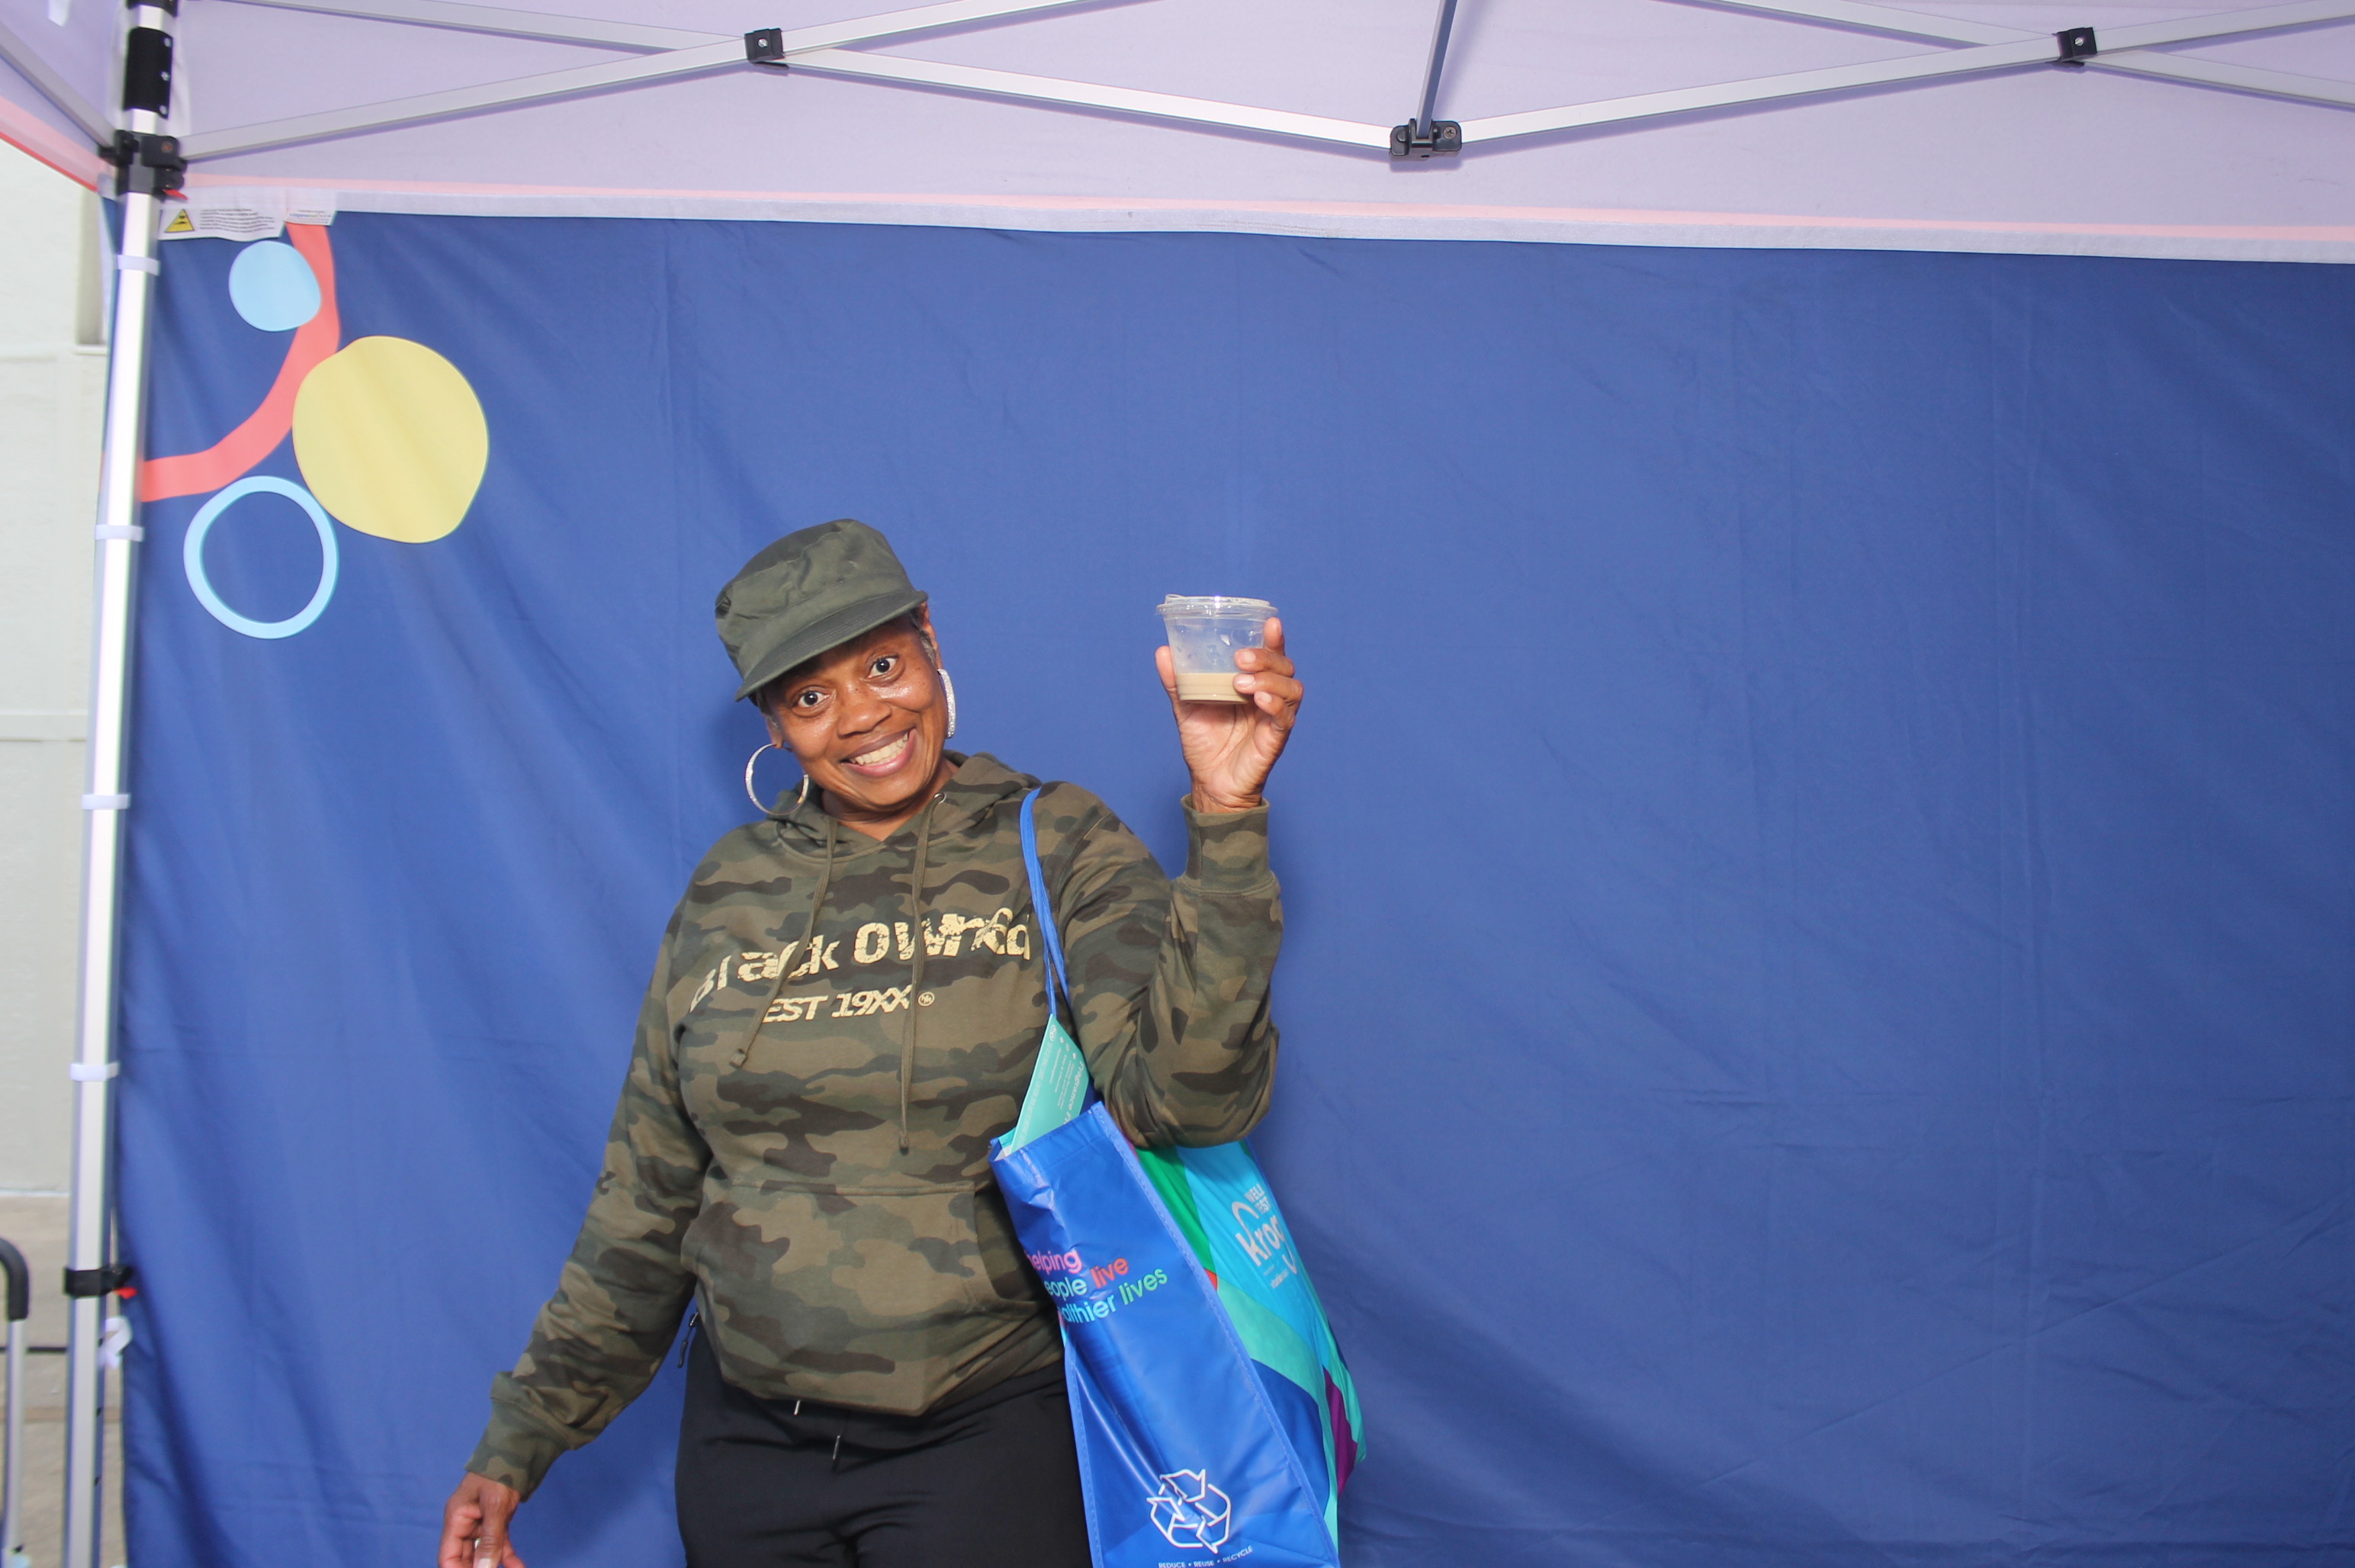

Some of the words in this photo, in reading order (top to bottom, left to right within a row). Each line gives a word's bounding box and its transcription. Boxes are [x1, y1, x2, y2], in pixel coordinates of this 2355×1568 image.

[762, 995, 829, 1023] EST
[831, 985, 913, 1018] 19XX
[1068, 1061, 1085, 1111] Fragrance
[1043, 1276, 1088, 1302] eople
[1090, 1257, 1129, 1289] live
[1058, 1294, 1117, 1323] althier
[1118, 1268, 1168, 1306] lives
[1193, 1560, 1215, 1568] REUSE
[1222, 1545, 1254, 1563] RECYCLE
